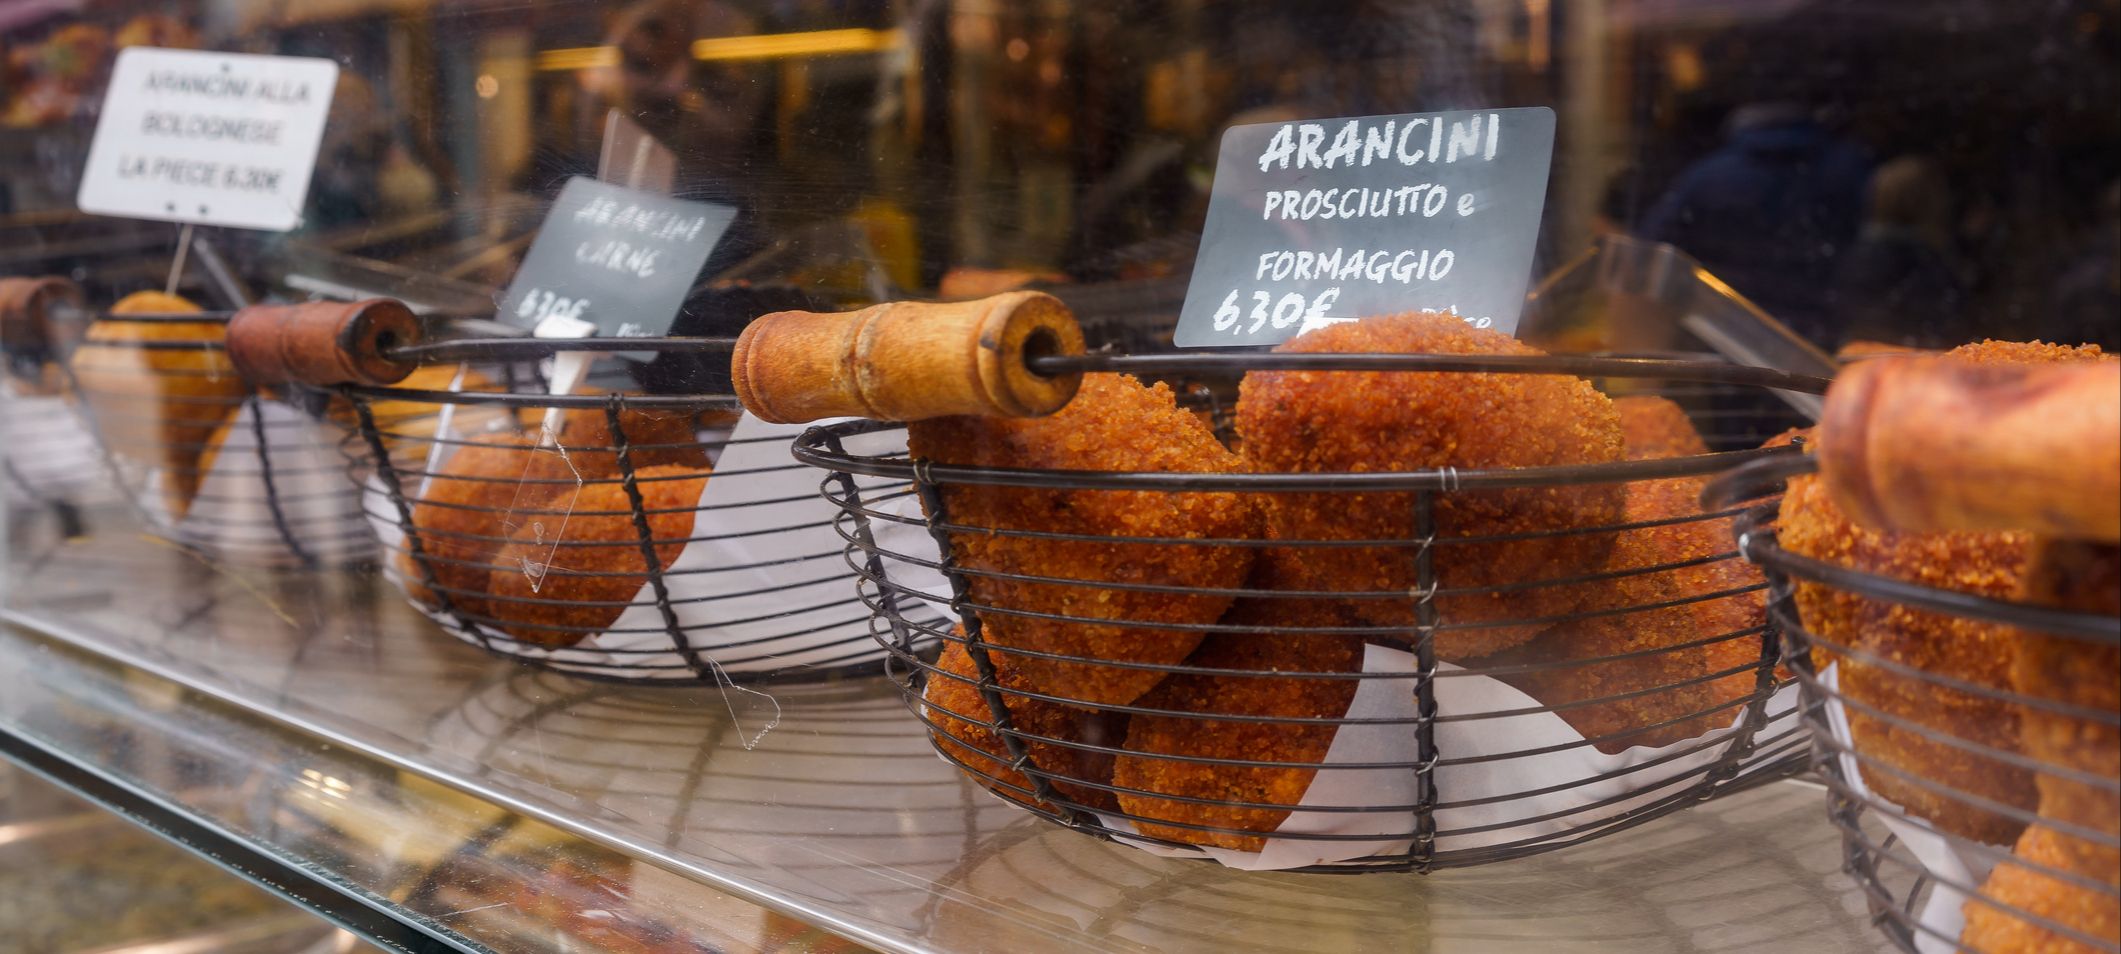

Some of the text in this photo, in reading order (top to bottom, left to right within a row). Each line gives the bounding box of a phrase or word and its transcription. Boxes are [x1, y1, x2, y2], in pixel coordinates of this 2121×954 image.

[144, 70, 311, 103] ARANCINI ALLA
[142, 110, 284, 144] BOLOGNESE
[1258, 113, 1500, 172] ARANCINI
[117, 154, 147, 179] LA
[152, 156, 219, 186] PIECE
[1263, 183, 1475, 220] PROSCIUTTO e
[575, 240, 662, 278] CARNE
[1256, 248, 1455, 283] FORMAGGIO
[1213, 287, 1340, 335] 6,30€
